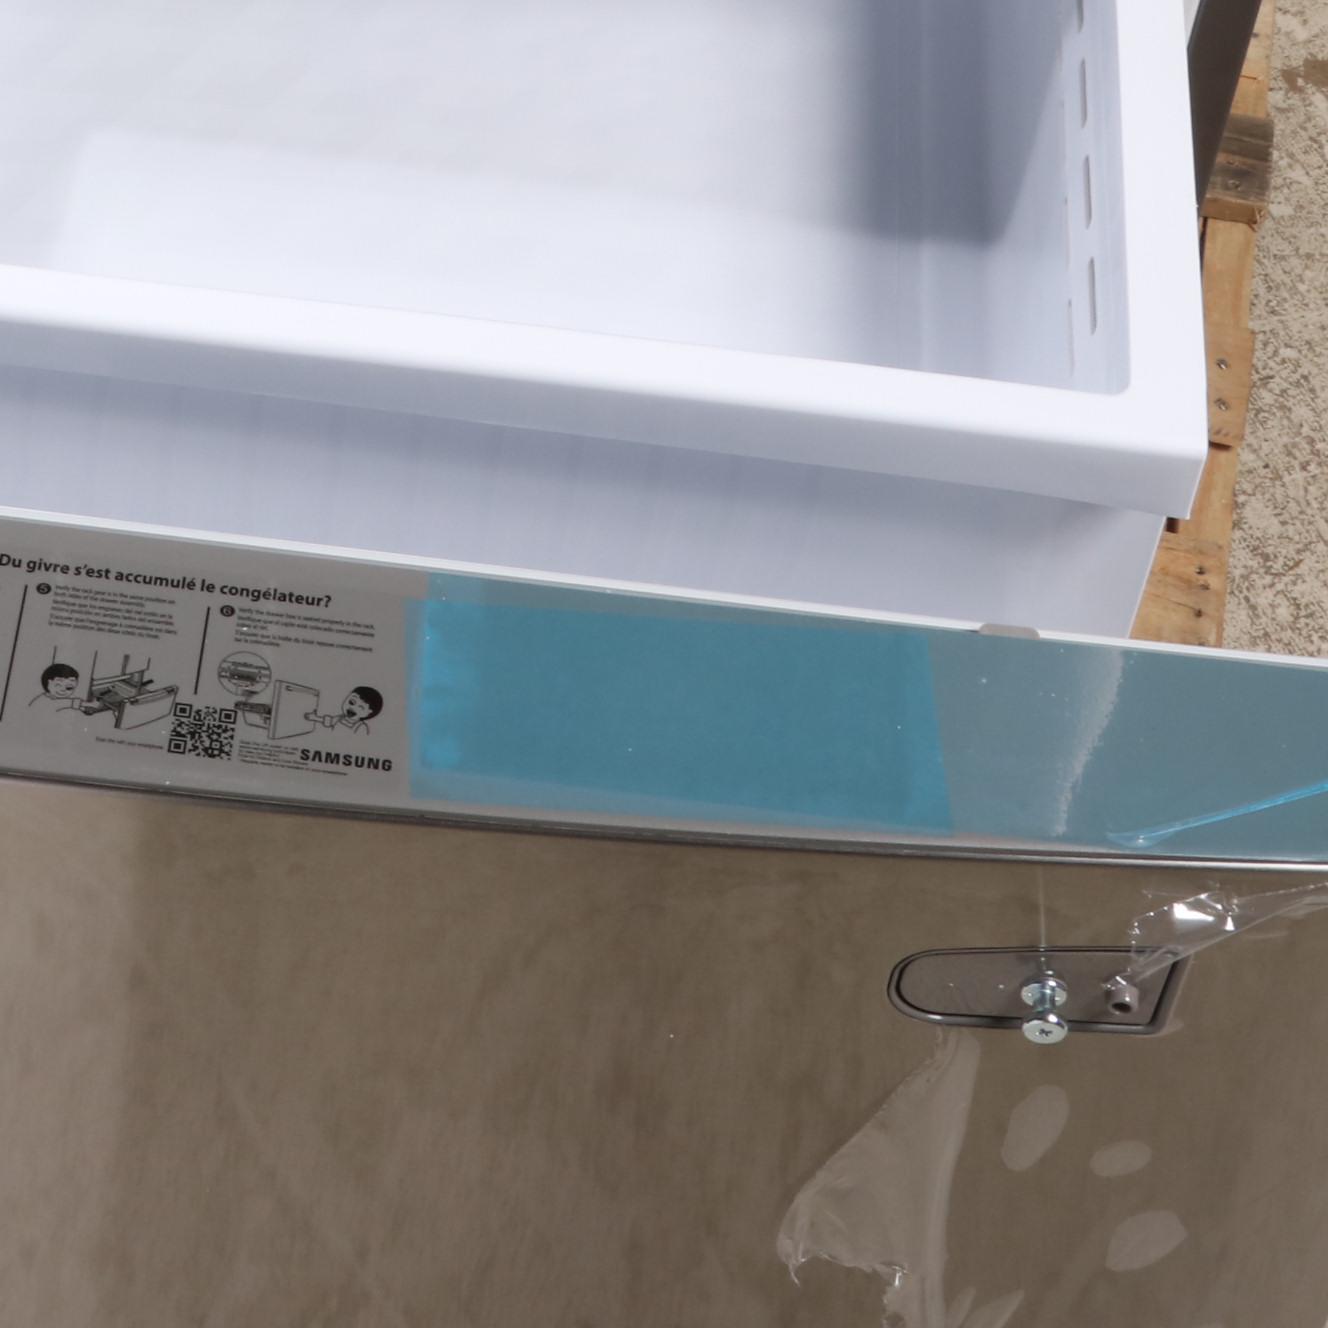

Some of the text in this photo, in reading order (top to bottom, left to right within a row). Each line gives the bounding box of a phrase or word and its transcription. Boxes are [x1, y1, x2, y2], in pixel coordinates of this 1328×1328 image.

[25, 556, 70, 573] givre
[113, 569, 196, 589] accumulé
[200, 577, 216, 592] le
[219, 582, 331, 607] congélateur?
[300, 748, 392, 772] SAMSUNG
